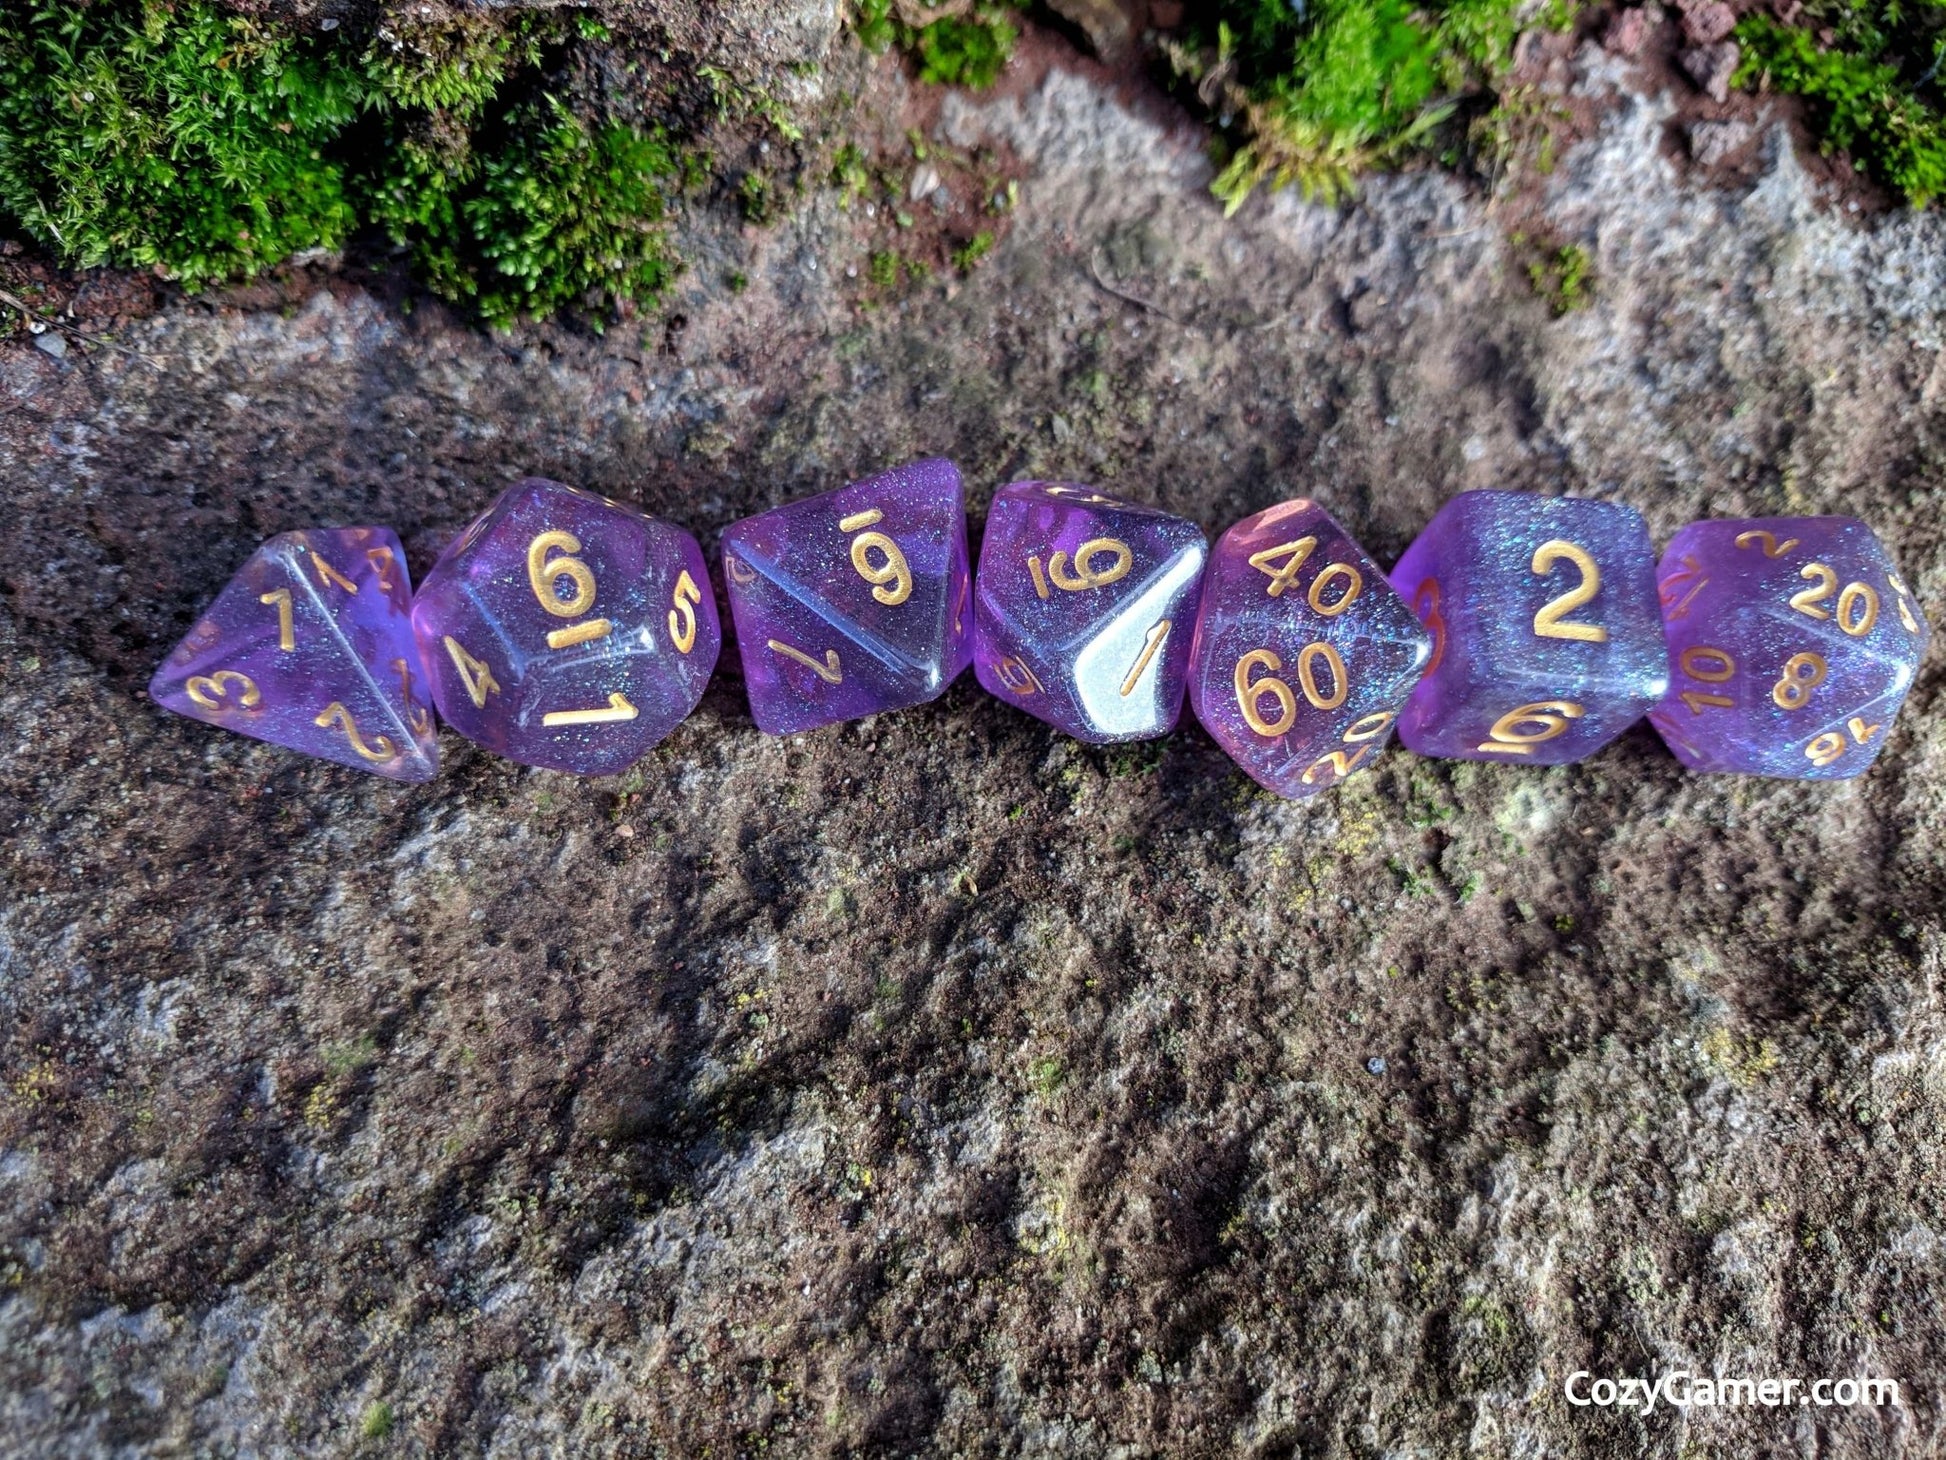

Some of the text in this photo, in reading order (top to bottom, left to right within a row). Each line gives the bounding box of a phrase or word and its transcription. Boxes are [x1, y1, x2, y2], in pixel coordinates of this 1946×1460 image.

[1248, 535, 1363, 617] 40
[1735, 530, 1799, 559] 2
[528, 530, 613, 649] 6
[668, 570, 701, 654] 5
[1531, 539, 1608, 643] 2
[1789, 562, 1879, 636] 20
[186, 670, 261, 709] 3
[444, 635, 500, 709] 4
[1119, 619, 1172, 697] 1
[1234, 641, 1348, 737] 60
[1679, 645, 1736, 715] 10
[1773, 652, 1828, 710] 8
[315, 701, 395, 762] 2
[543, 692, 639, 727] 1
